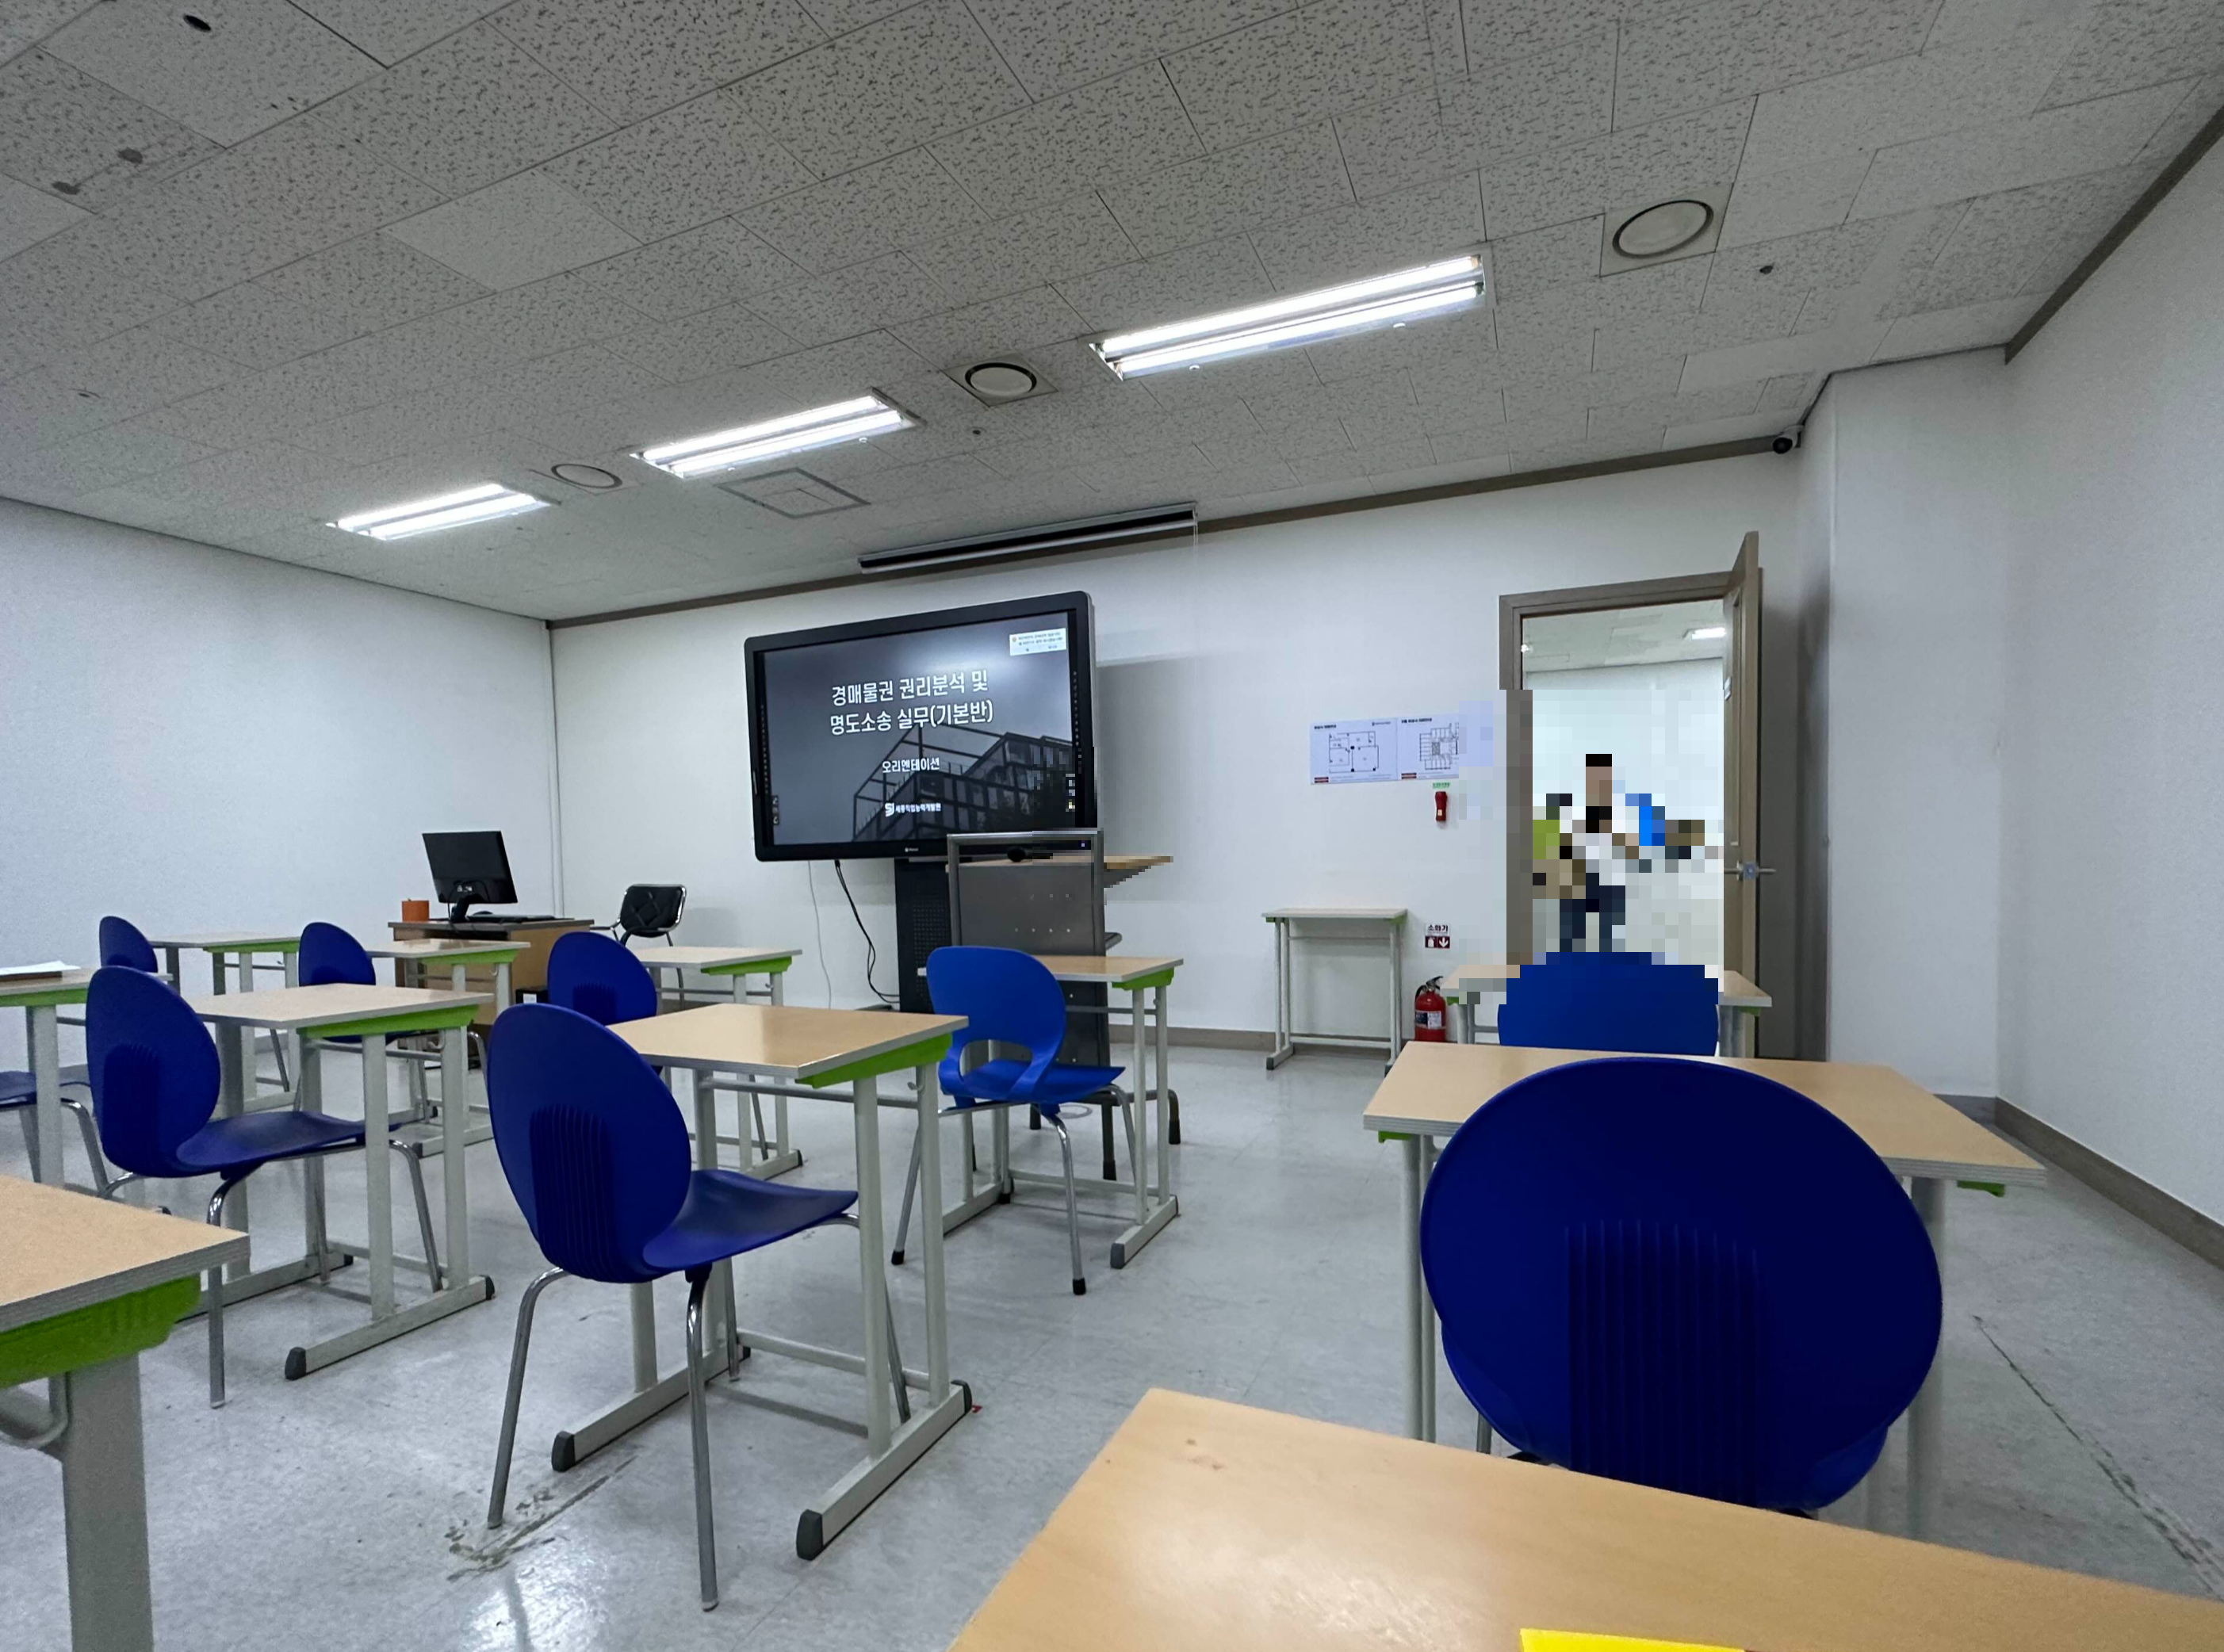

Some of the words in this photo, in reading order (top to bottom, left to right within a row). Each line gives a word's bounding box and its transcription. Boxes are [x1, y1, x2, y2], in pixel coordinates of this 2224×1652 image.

[832, 680, 894, 706] 경매물권
[899, 672, 965, 699] 권리분석
[971, 669, 988, 692] 및
[830, 710, 891, 736] 명도소송
[898, 699, 993, 729] 실무(기본반)
[882, 757, 940, 773] 오리엔테이션
